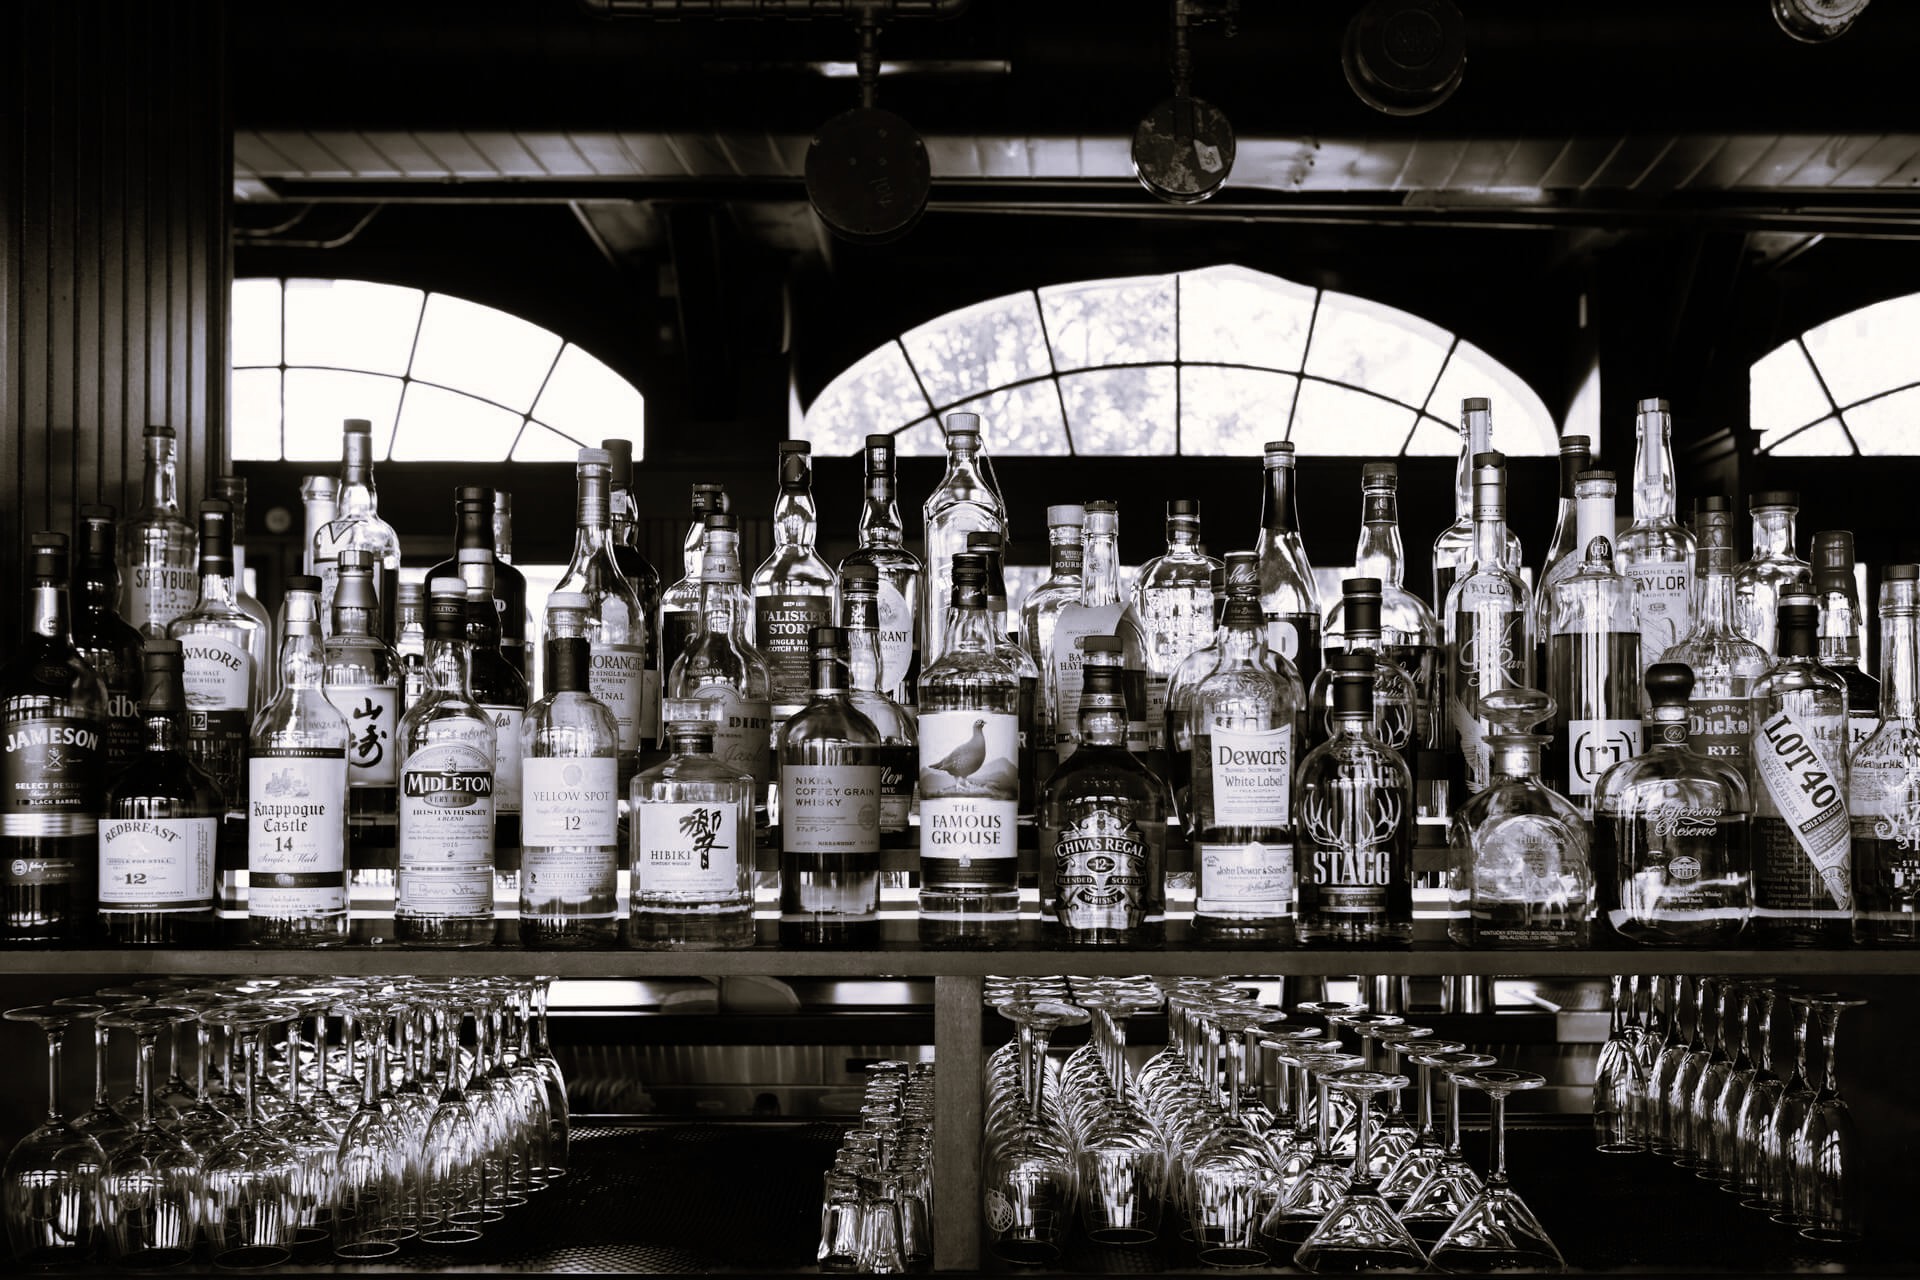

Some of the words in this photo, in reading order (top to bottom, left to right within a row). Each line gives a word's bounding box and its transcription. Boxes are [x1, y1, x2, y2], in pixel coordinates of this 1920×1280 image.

[761, 611, 830, 622] TALISKER
[1705, 704, 1743, 716] GEORGE
[192, 716, 205, 727] 12
[6, 727, 98, 752] JAMESON
[1218, 746, 1287, 766] Dewar's
[1707, 746, 1740, 755] RYE
[1764, 714, 1818, 772] LOT
[1800, 771, 1837, 809] 40
[407, 772, 491, 795] MIDLETON
[795, 777, 832, 785] NIKKA
[533, 791, 581, 801] YELLOW
[584, 791, 610, 801] SPOT
[795, 788, 840, 796] COFFEY
[844, 788, 874, 796] GRAIN
[254, 801, 325, 818] Knappogue
[795, 799, 841, 807] WHISKY
[953, 804, 977, 813] THE
[413, 808, 441, 816] IRISH
[443, 808, 487, 816] WHISKEY
[1648, 800, 1722, 820] Jefferson's
[564, 815, 581, 831] 12
[932, 815, 1002, 828] FAMOUS
[1801, 818, 1819, 833] 2012
[1817, 801, 1842, 825] RELEASE
[104, 821, 179, 844] REDBREAST
[263, 819, 308, 833] Castle
[1655, 815, 1718, 838] Reserve
[931, 830, 1001, 845] GROUSE
[275, 837, 293, 852] 14
[1057, 839, 1102, 857] CHIVAS
[1105, 839, 1145, 859] REGAL
[651, 850, 691, 860] HIBIKI
[1094, 859, 1107, 871] 12
[1314, 851, 1390, 886] STAGG
[125, 873, 147, 885] 12
[1058, 875, 1093, 884] BLENDED
[1111, 875, 1143, 884] SCOTCH
[1084, 894, 1119, 905] WHISKY
